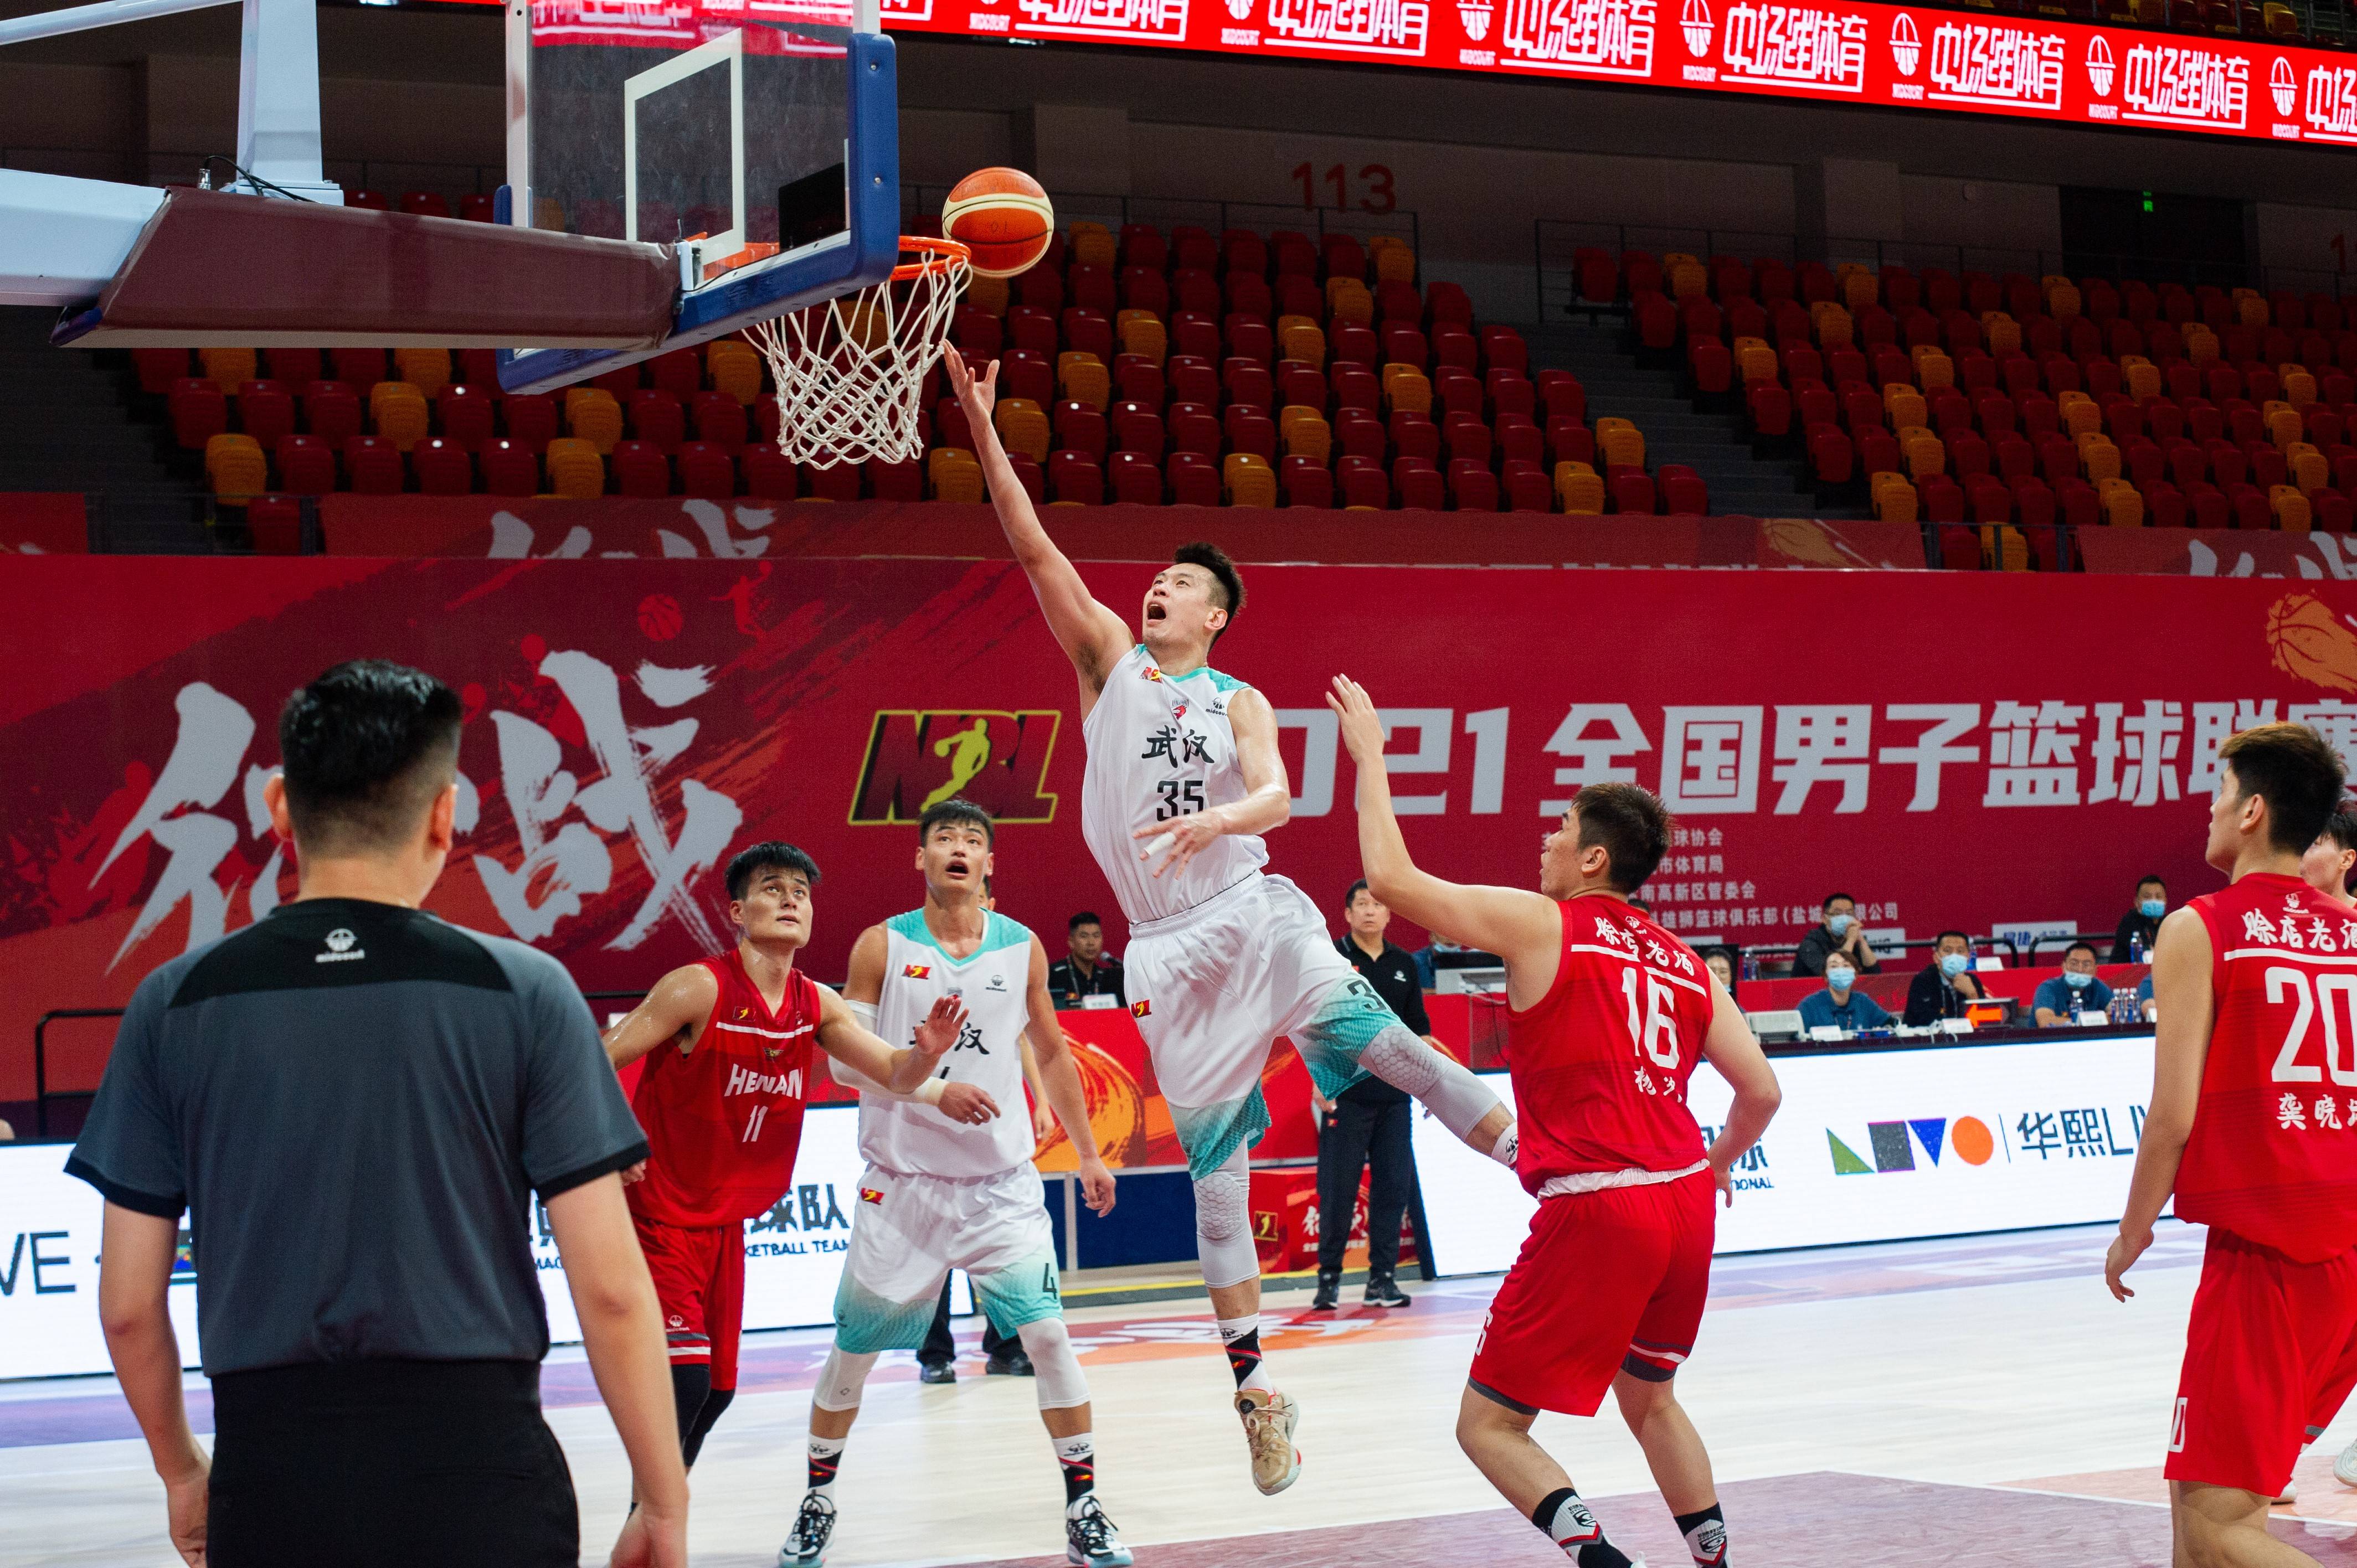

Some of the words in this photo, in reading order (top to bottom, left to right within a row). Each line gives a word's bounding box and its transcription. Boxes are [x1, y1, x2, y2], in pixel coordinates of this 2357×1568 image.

[1293, 162, 1397, 214] 113
[1141, 725, 1215, 768] 武汉
[1156, 780, 1204, 822] 35
[1666, 827, 1723, 847] 球协会
[1653, 854, 1723, 875] 市体育局
[1629, 880, 1756, 902] 南高新区管委会
[1622, 967, 1680, 1070] 16
[2264, 967, 2357, 1087] 20
[724, 1064, 802, 1100] HENAN
[742, 1105, 768, 1143] 11
[1042, 1263, 1057, 1300] 4
